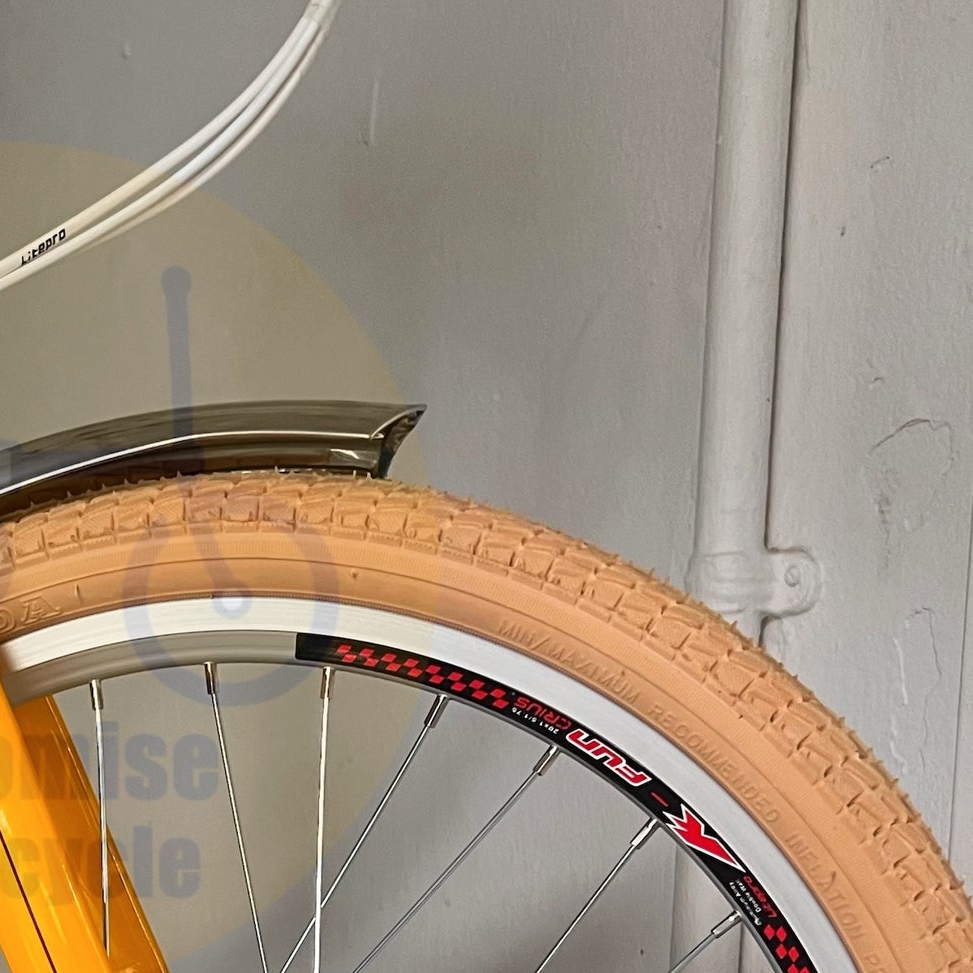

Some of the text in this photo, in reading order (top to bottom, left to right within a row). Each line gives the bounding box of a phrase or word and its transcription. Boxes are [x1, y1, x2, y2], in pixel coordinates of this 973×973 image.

[21, 228, 66, 266] Litepro
[514, 696, 572, 731] CRIUS
[647, 704, 780, 825] RECOMMENDED
[784, 832, 866, 942] INFLATION
